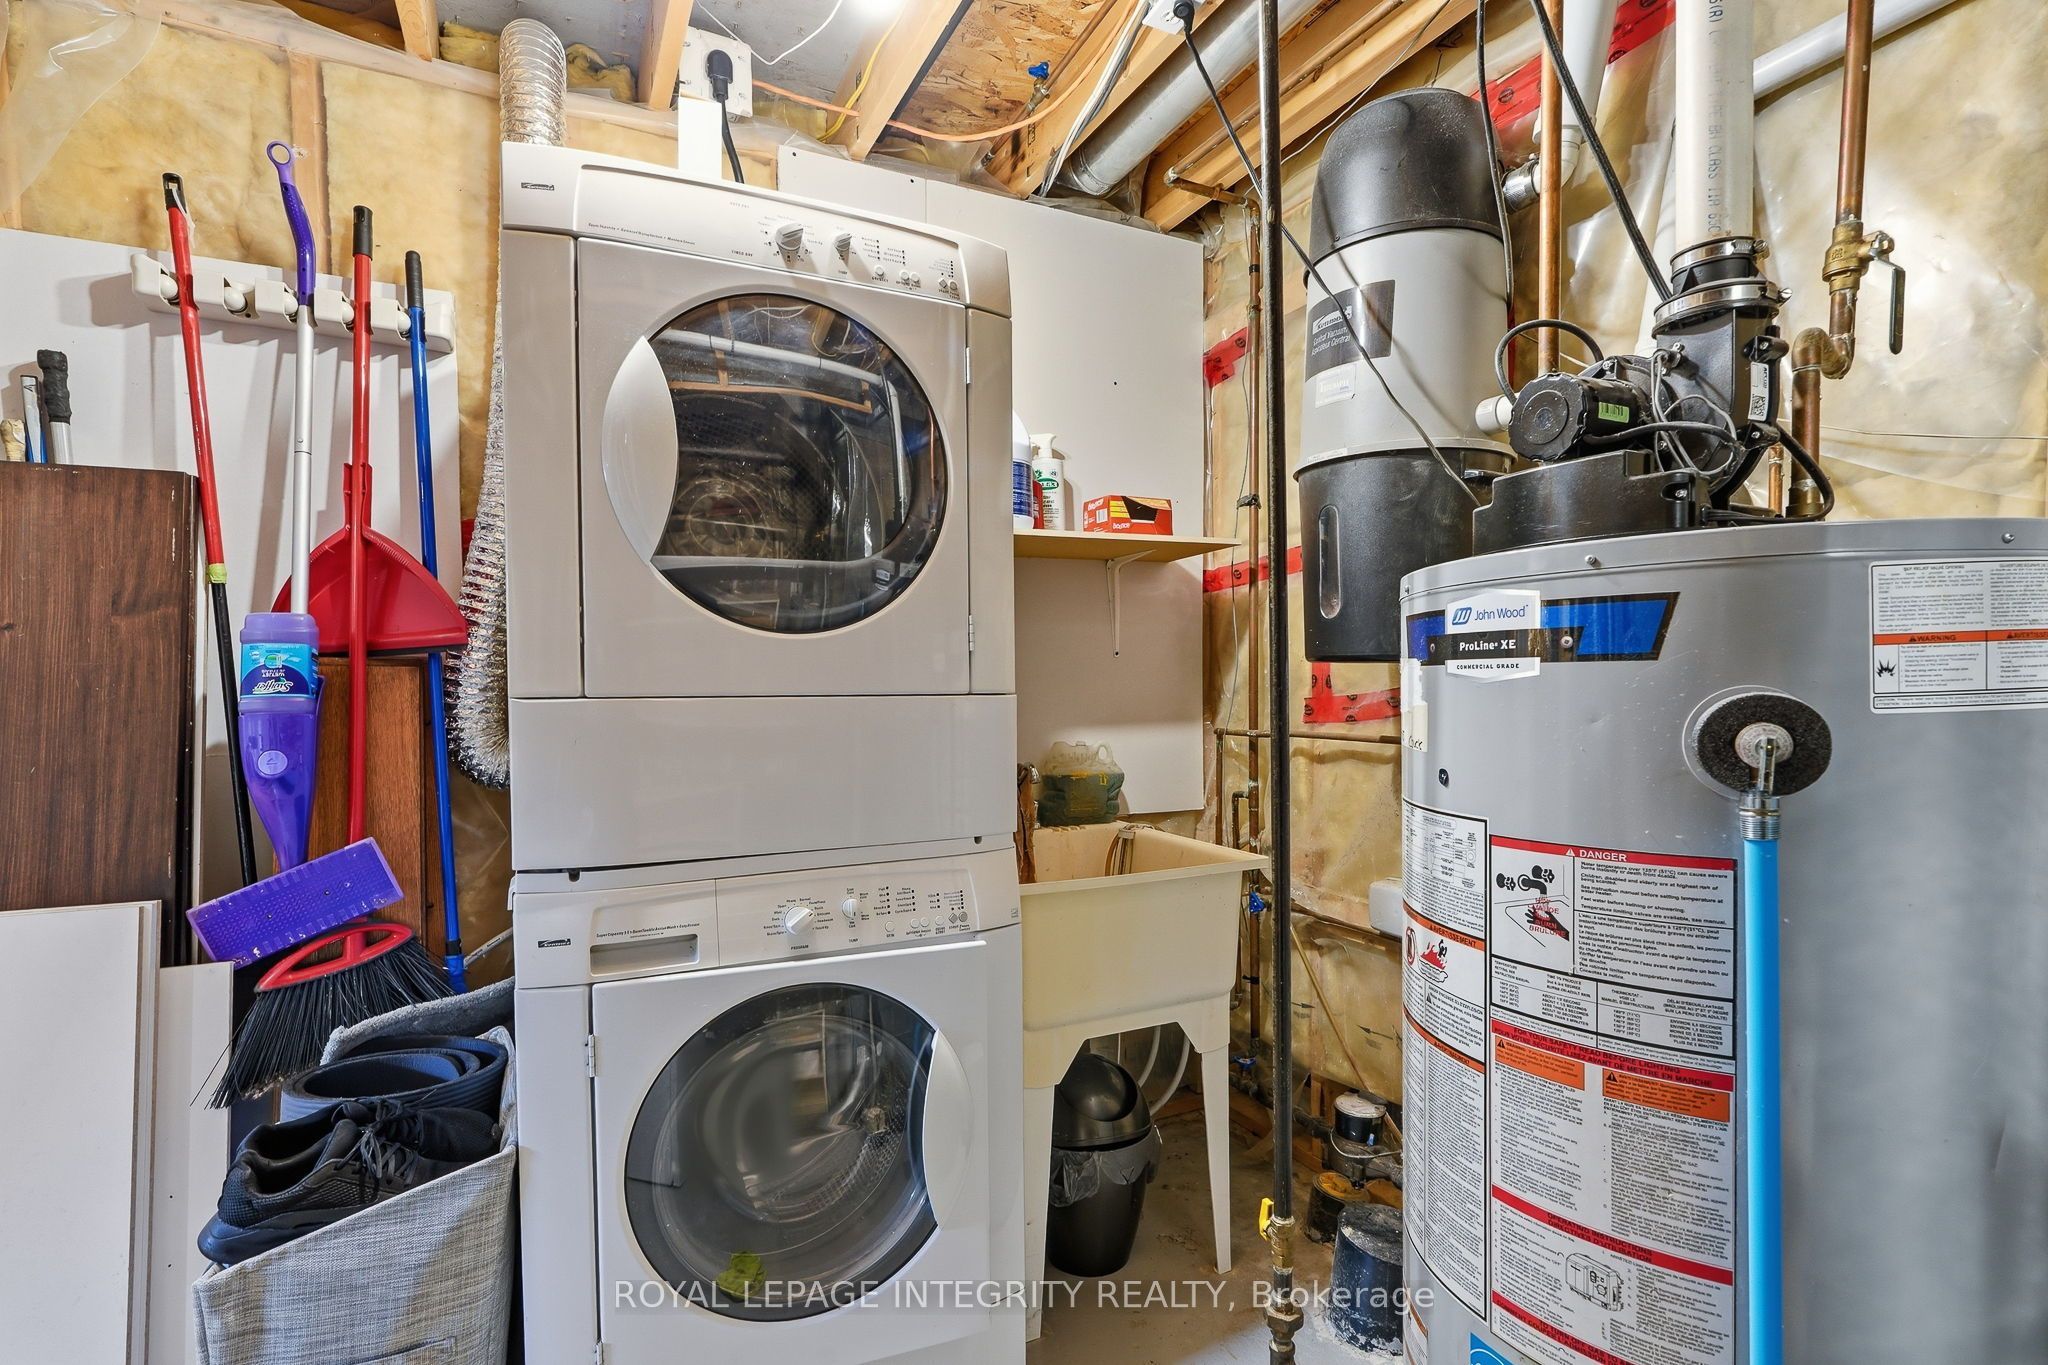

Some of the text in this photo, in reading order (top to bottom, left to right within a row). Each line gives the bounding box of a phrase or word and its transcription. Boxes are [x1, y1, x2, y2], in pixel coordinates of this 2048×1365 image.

[1475, 606, 1526, 621] John Wood
[1500, 640, 1516, 650] XE
[1917, 634, 1957, 642] WARNING
[252, 678, 294, 695] Swiffer
[1580, 849, 1627, 862] DANGER
[1603, 1052, 1636, 1065] BEFORE
[1640, 1060, 1681, 1073] LIGHTING
[1614, 1061, 1626, 1070] DE
[1627, 1064, 1658, 1077] METTRE
[1661, 1070, 1672, 1080] EN
[1675, 1073, 1712, 1087] MARCHE
